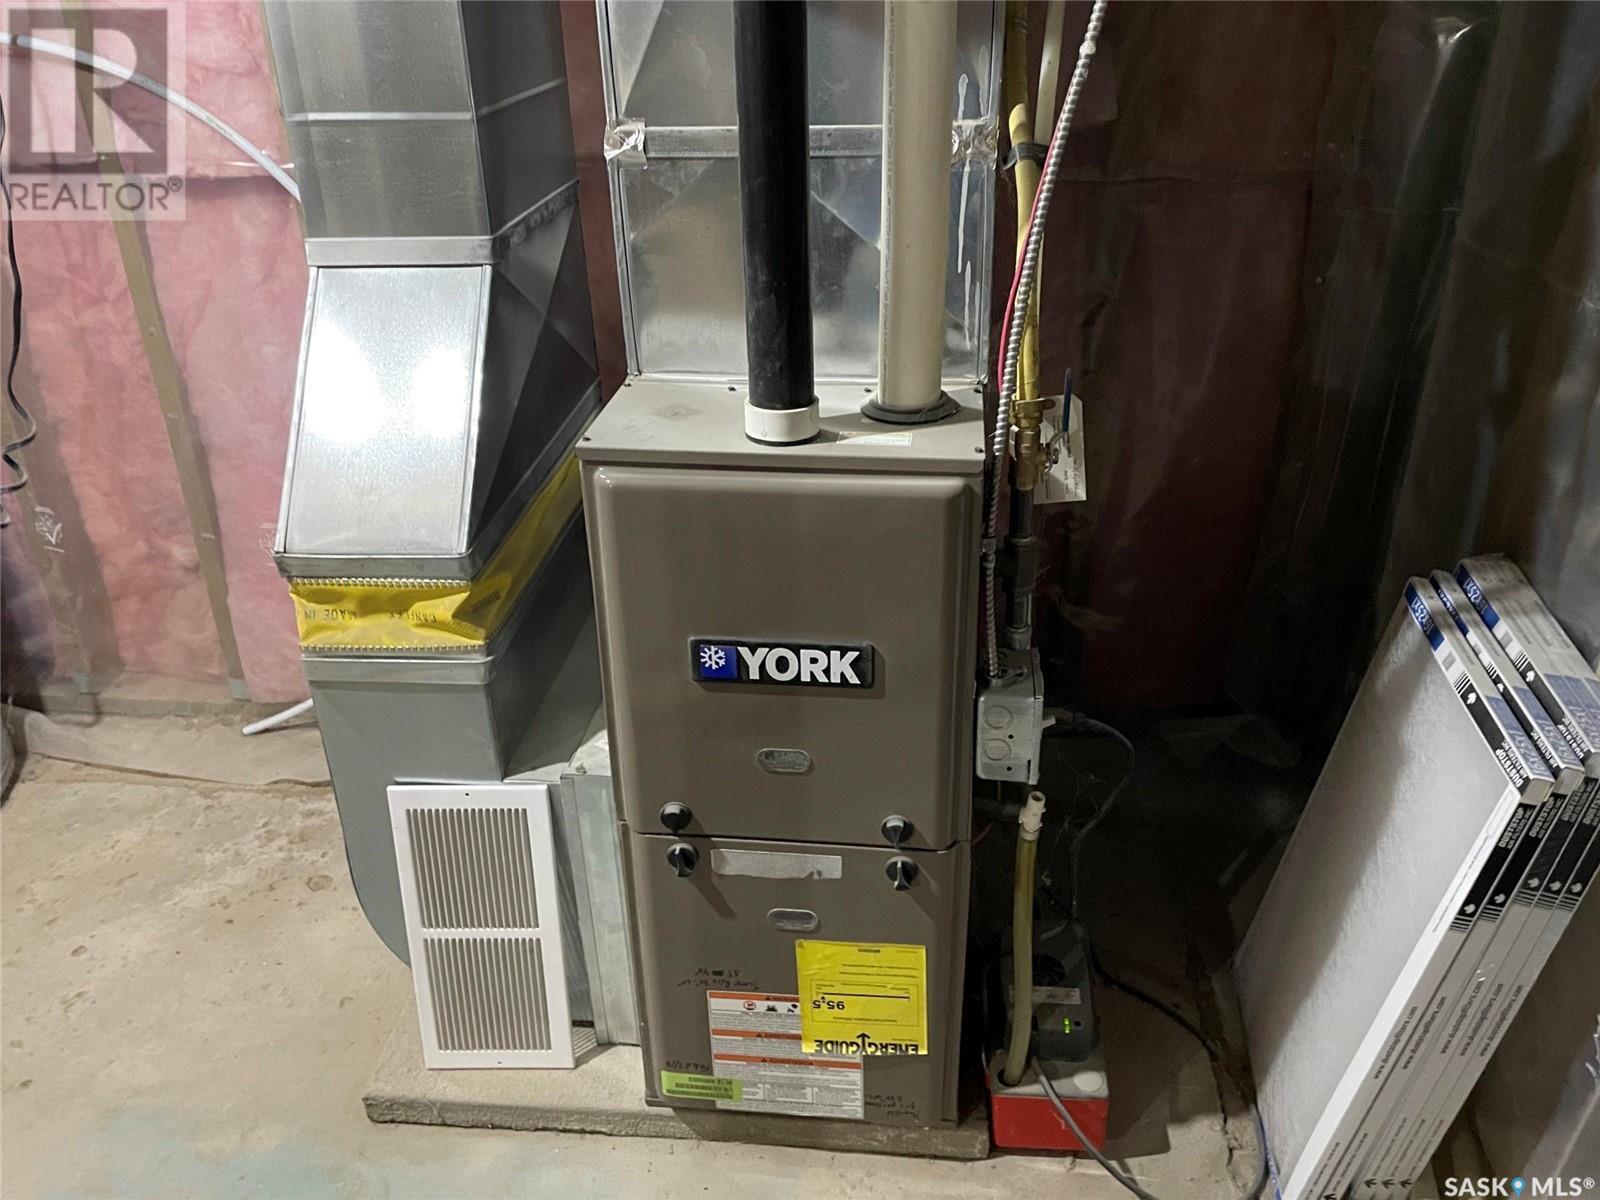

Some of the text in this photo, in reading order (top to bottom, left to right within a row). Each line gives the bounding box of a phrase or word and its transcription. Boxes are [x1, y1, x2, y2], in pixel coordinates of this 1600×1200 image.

[736, 646, 862, 685] YORK
[1495, 748, 1524, 788] DUSTSTOP
[1499, 807, 1525, 848] DUSTSTOP
[1528, 796, 1555, 838] DUSTSTOP
[812, 1000, 846, 1011] 95.5
